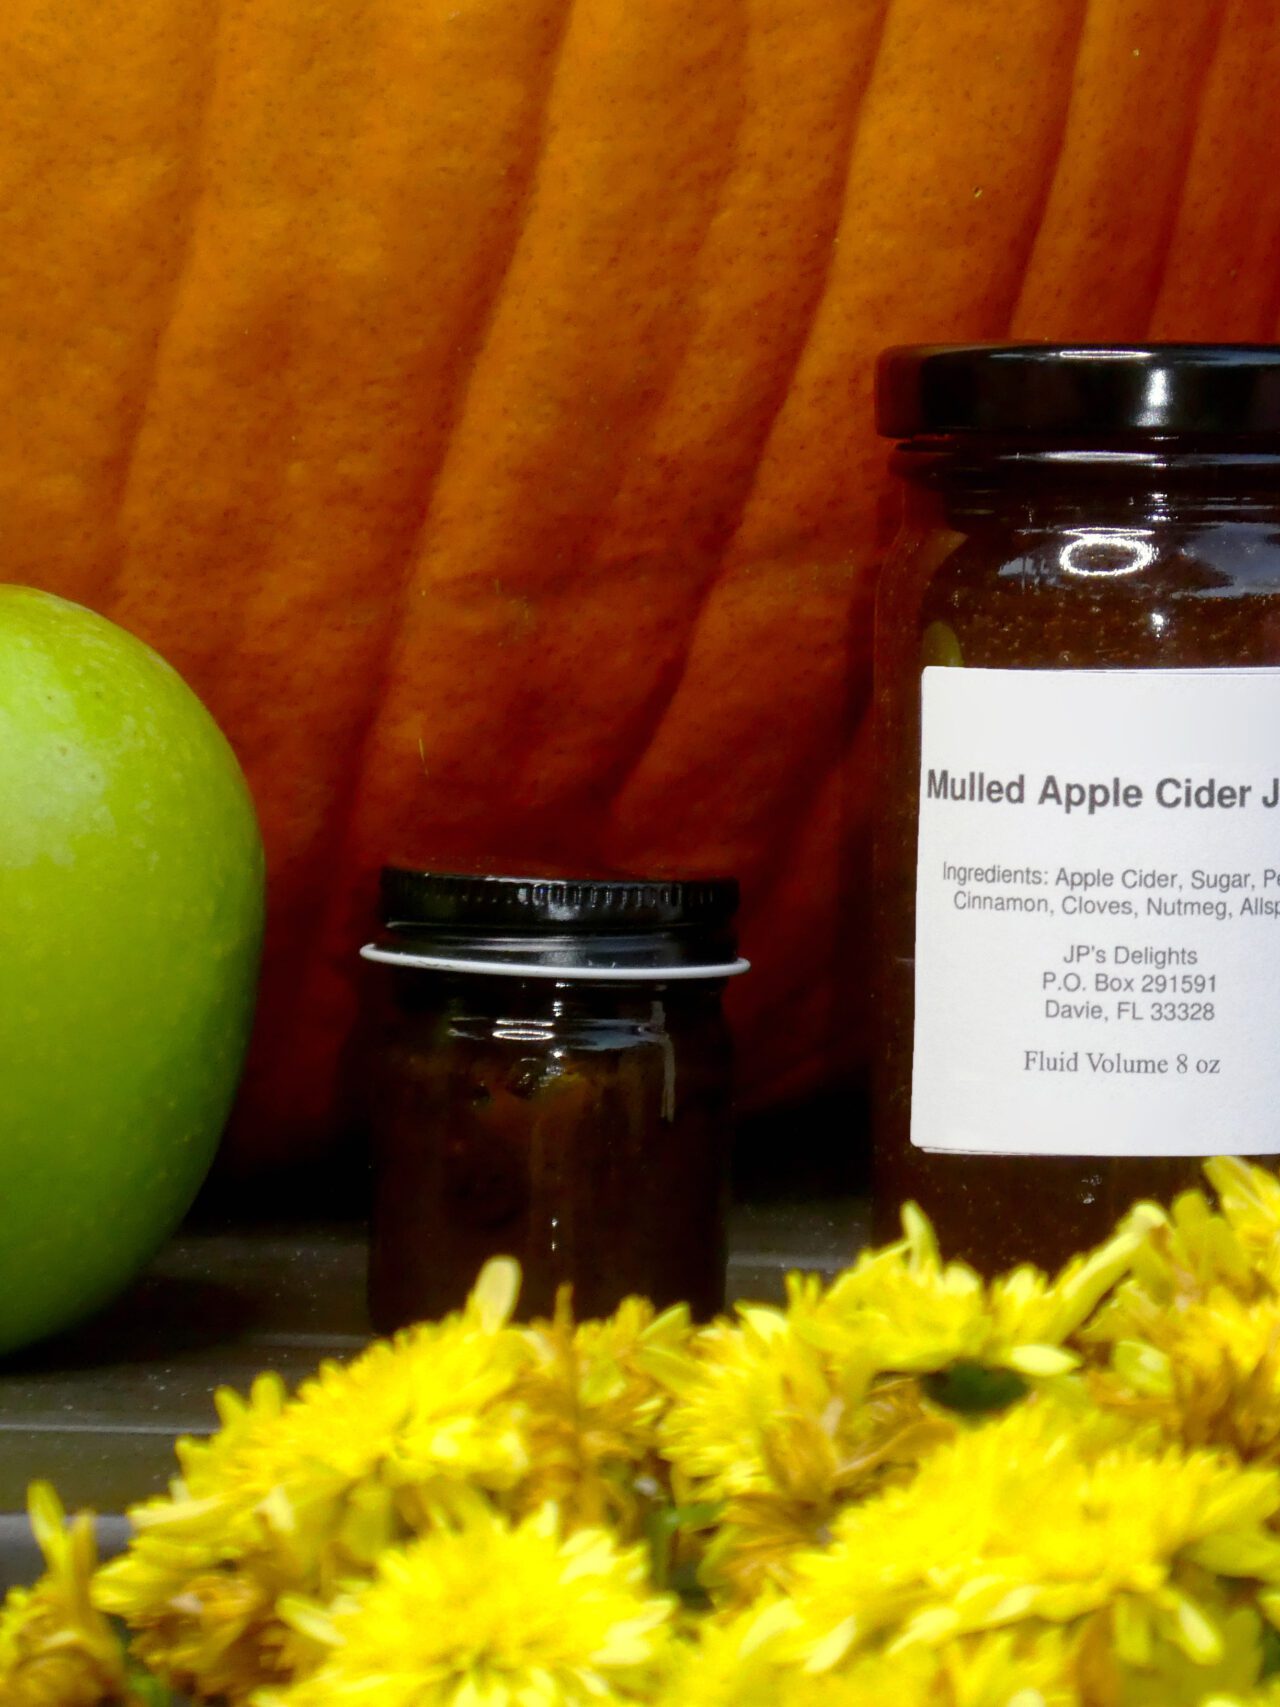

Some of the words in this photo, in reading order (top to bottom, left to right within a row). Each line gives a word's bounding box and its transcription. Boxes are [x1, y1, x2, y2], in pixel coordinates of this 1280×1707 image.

[926, 768, 1026, 805] Mulled
[1037, 774, 1144, 816] Apple
[1154, 776, 1253, 810] Cider
[942, 861, 1049, 887] Ingredients:
[1054, 867, 1115, 892] Apple
[1120, 868, 1183, 892] Cider,
[1190, 869, 1256, 894] Sugar,
[953, 889, 1055, 915] Cinnamon,
[1061, 895, 1139, 919] Cloves,
[1146, 896, 1233, 921] Nutmeg,
[1063, 944, 1107, 965] JP's
[1114, 945, 1198, 970] Delights
[1042, 971, 1088, 993] P.O.
[1094, 973, 1135, 993] Box
[1140, 973, 1217, 994] 291591
[1045, 999, 1109, 1023] Davie,
[1116, 1001, 1145, 1021] FL
[1150, 1001, 1216, 1022] 33328
[1023, 1050, 1079, 1073] Fluid
[1085, 1052, 1169, 1075] Volume
[1176, 1053, 1189, 1074] 8
[1195, 1058, 1221, 1074] oz
